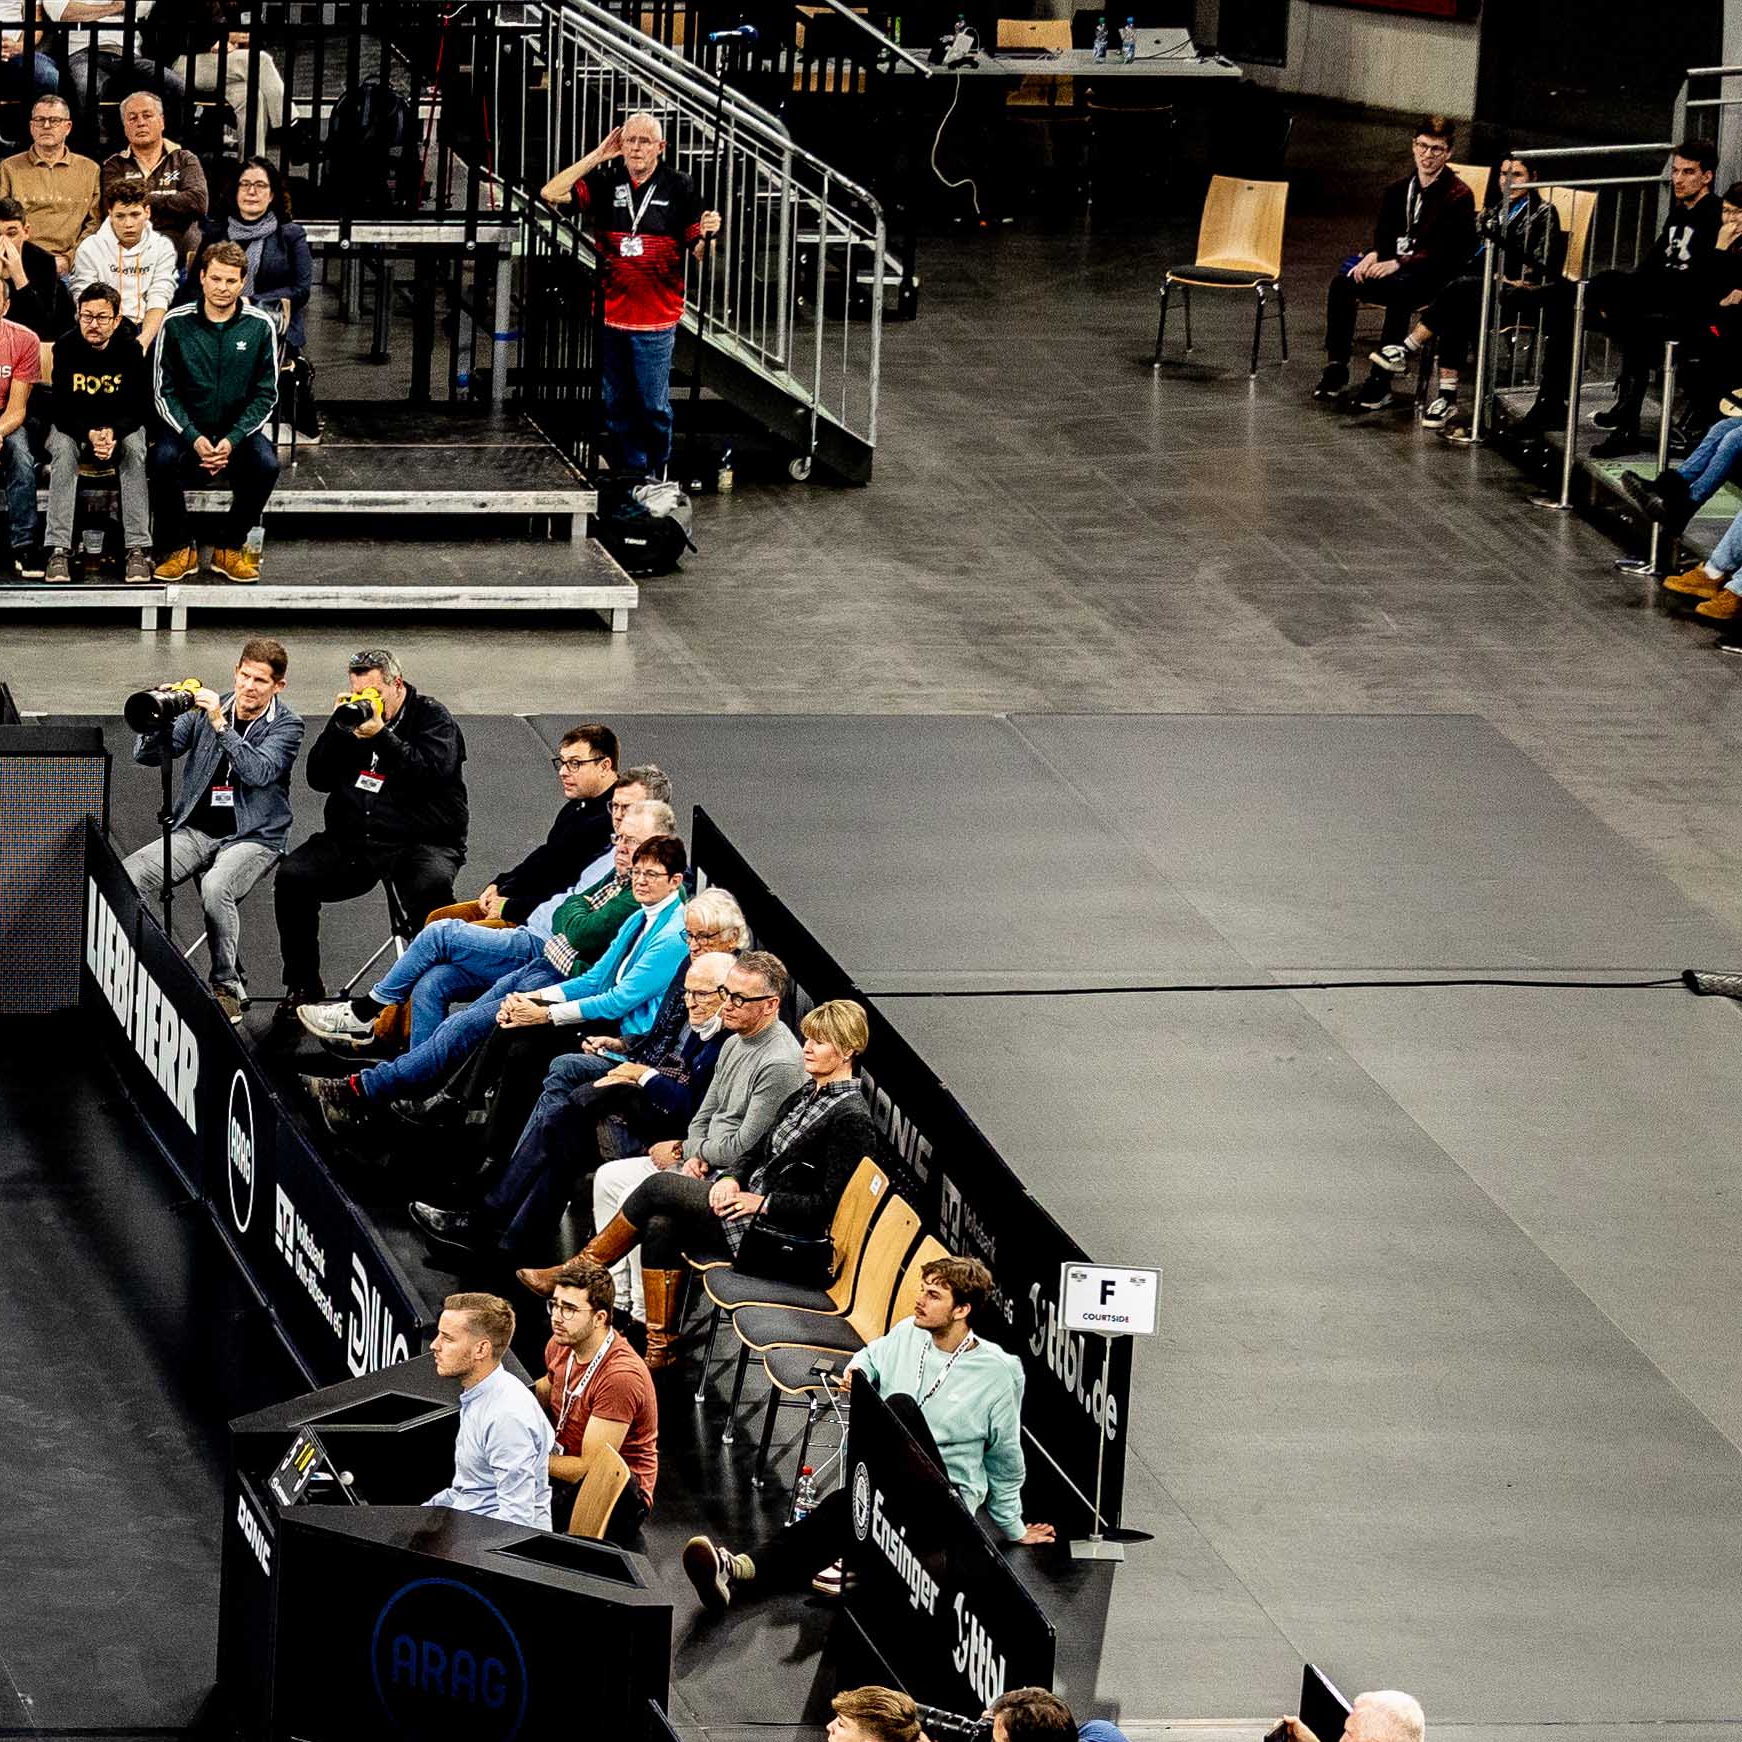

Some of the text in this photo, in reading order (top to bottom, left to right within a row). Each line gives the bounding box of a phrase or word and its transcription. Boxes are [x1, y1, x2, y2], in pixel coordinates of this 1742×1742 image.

[86, 874, 200, 1134] LIEBHERR
[230, 1115, 251, 1186] ARAG
[295, 1213, 326, 1280] Volksbank
[1082, 1312, 1130, 1324] COURTSIDE
[1099, 1279, 1117, 1306] F
[237, 1494, 271, 1577] DONIC
[872, 1489, 941, 1617] Ensinger
[390, 1634, 509, 1709] ARAG
